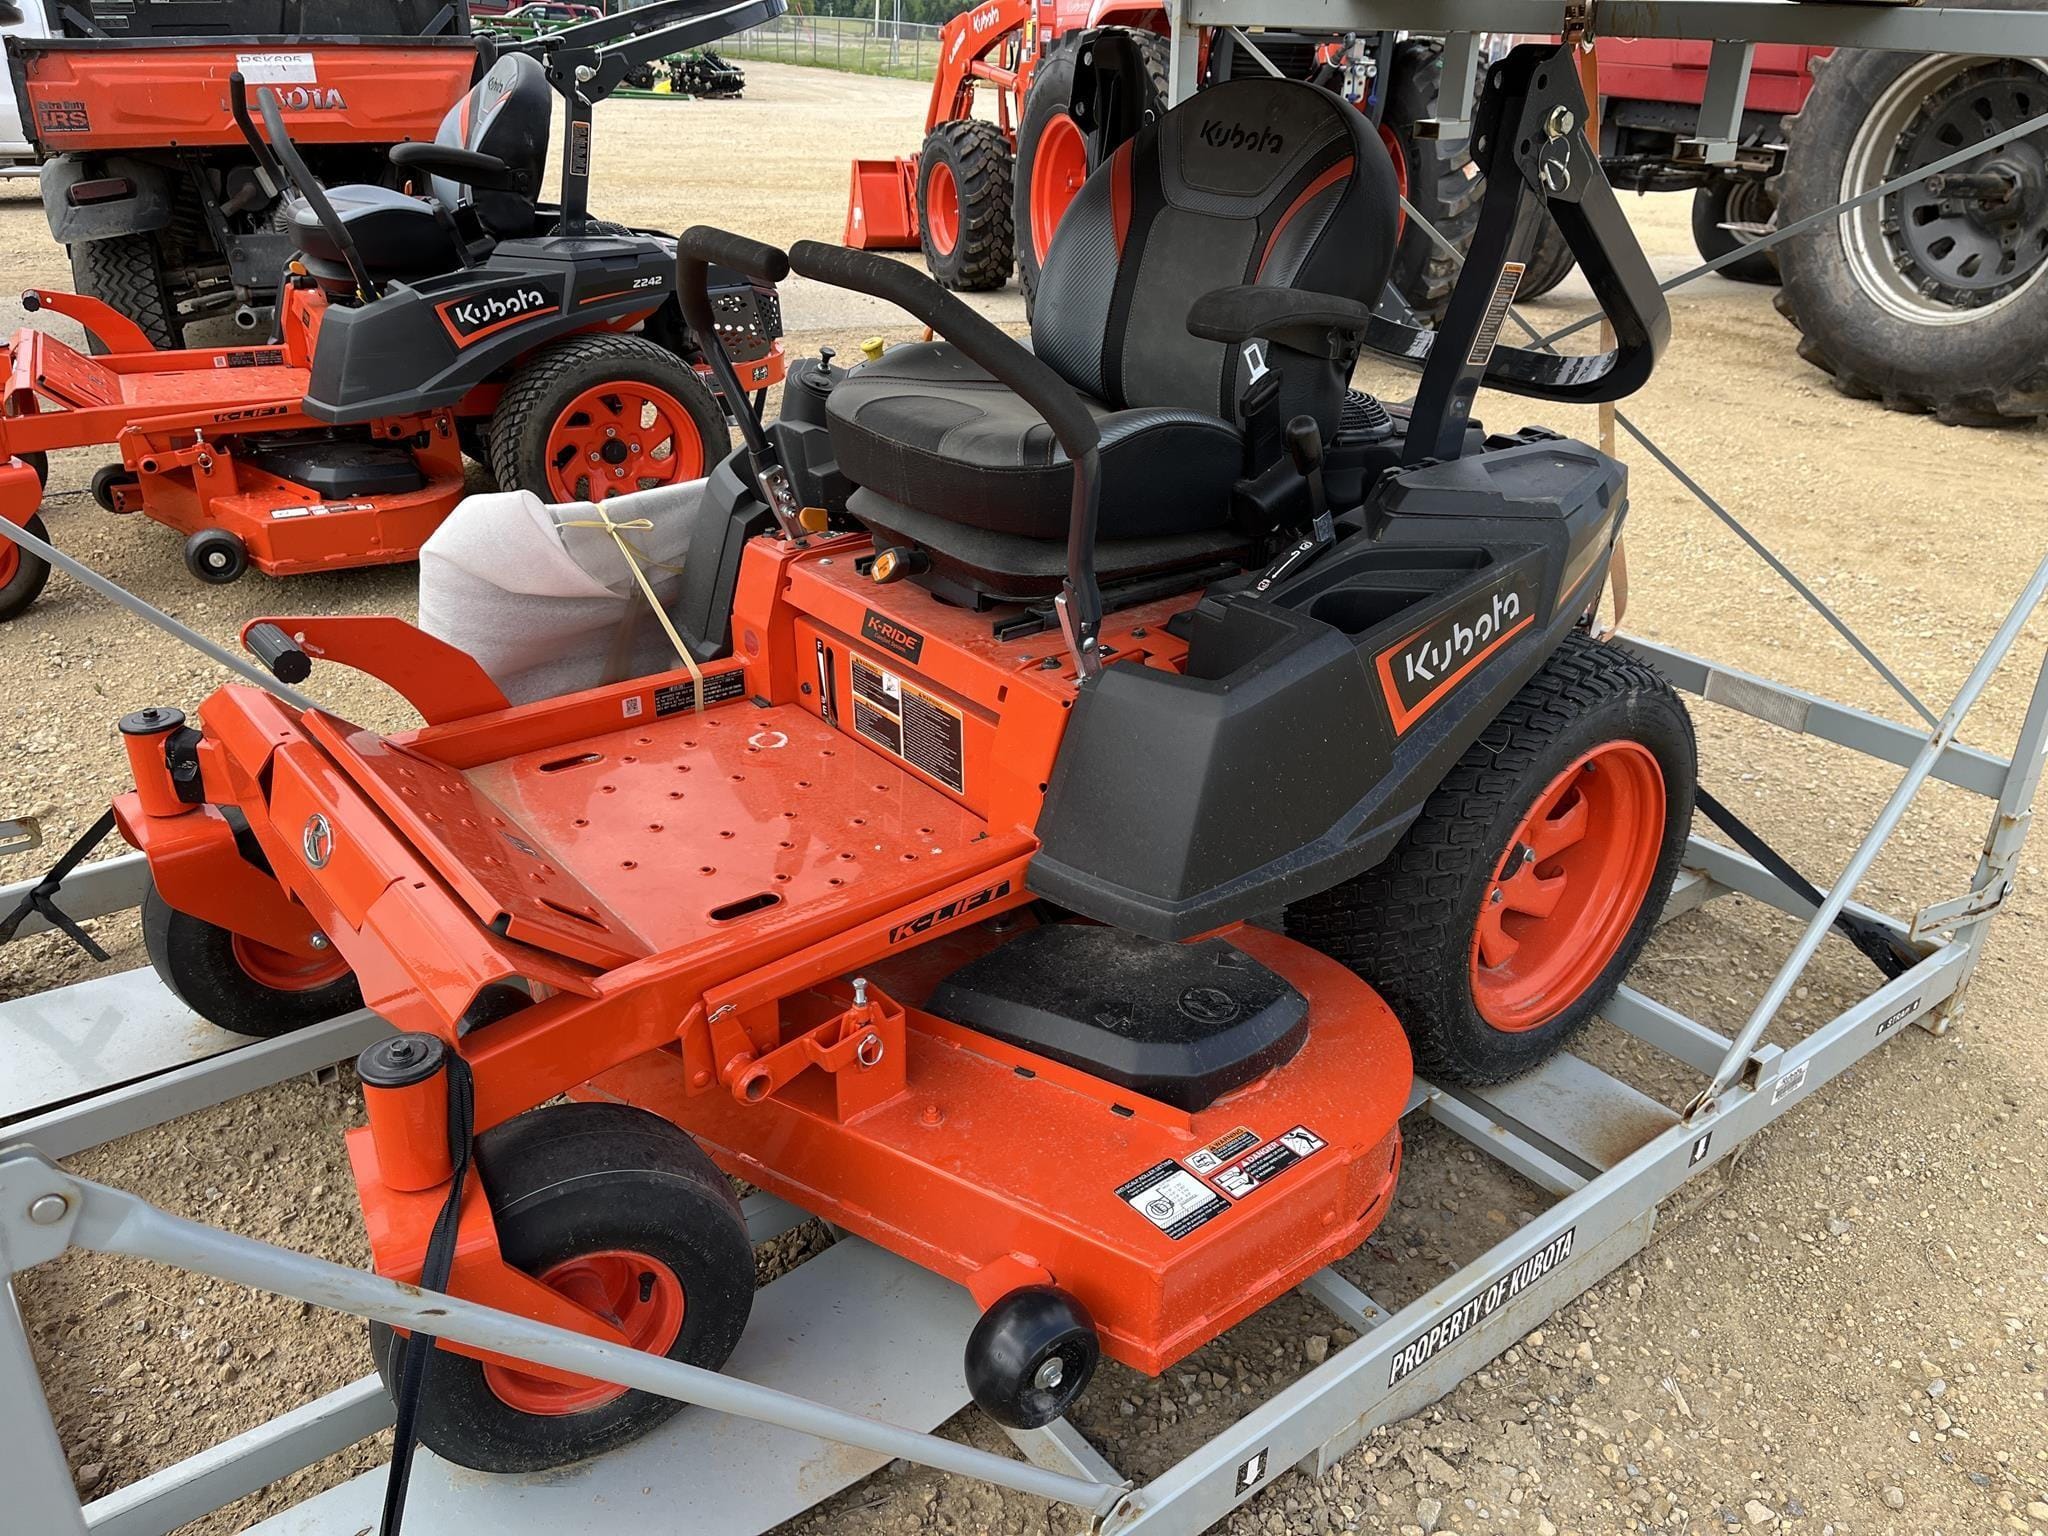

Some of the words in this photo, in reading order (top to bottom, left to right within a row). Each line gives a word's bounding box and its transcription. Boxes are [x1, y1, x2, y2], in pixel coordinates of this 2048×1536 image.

[41, 111, 87, 127] IRS
[1200, 119, 1284, 154] Kubota
[633, 276, 663, 289] Z242
[455, 289, 544, 325] Kubota
[867, 616, 918, 651] K-RIDE
[1405, 592, 1520, 683] Kubota
[893, 881, 1008, 944] K-LIFT
[1213, 1128, 1244, 1148] WARNING
[1246, 1142, 1278, 1162] DANGER
[1389, 1294, 1484, 1385] PROPERTY
[1485, 1278, 1511, 1315] OF
[1509, 1230, 1574, 1298] KUBOTA
